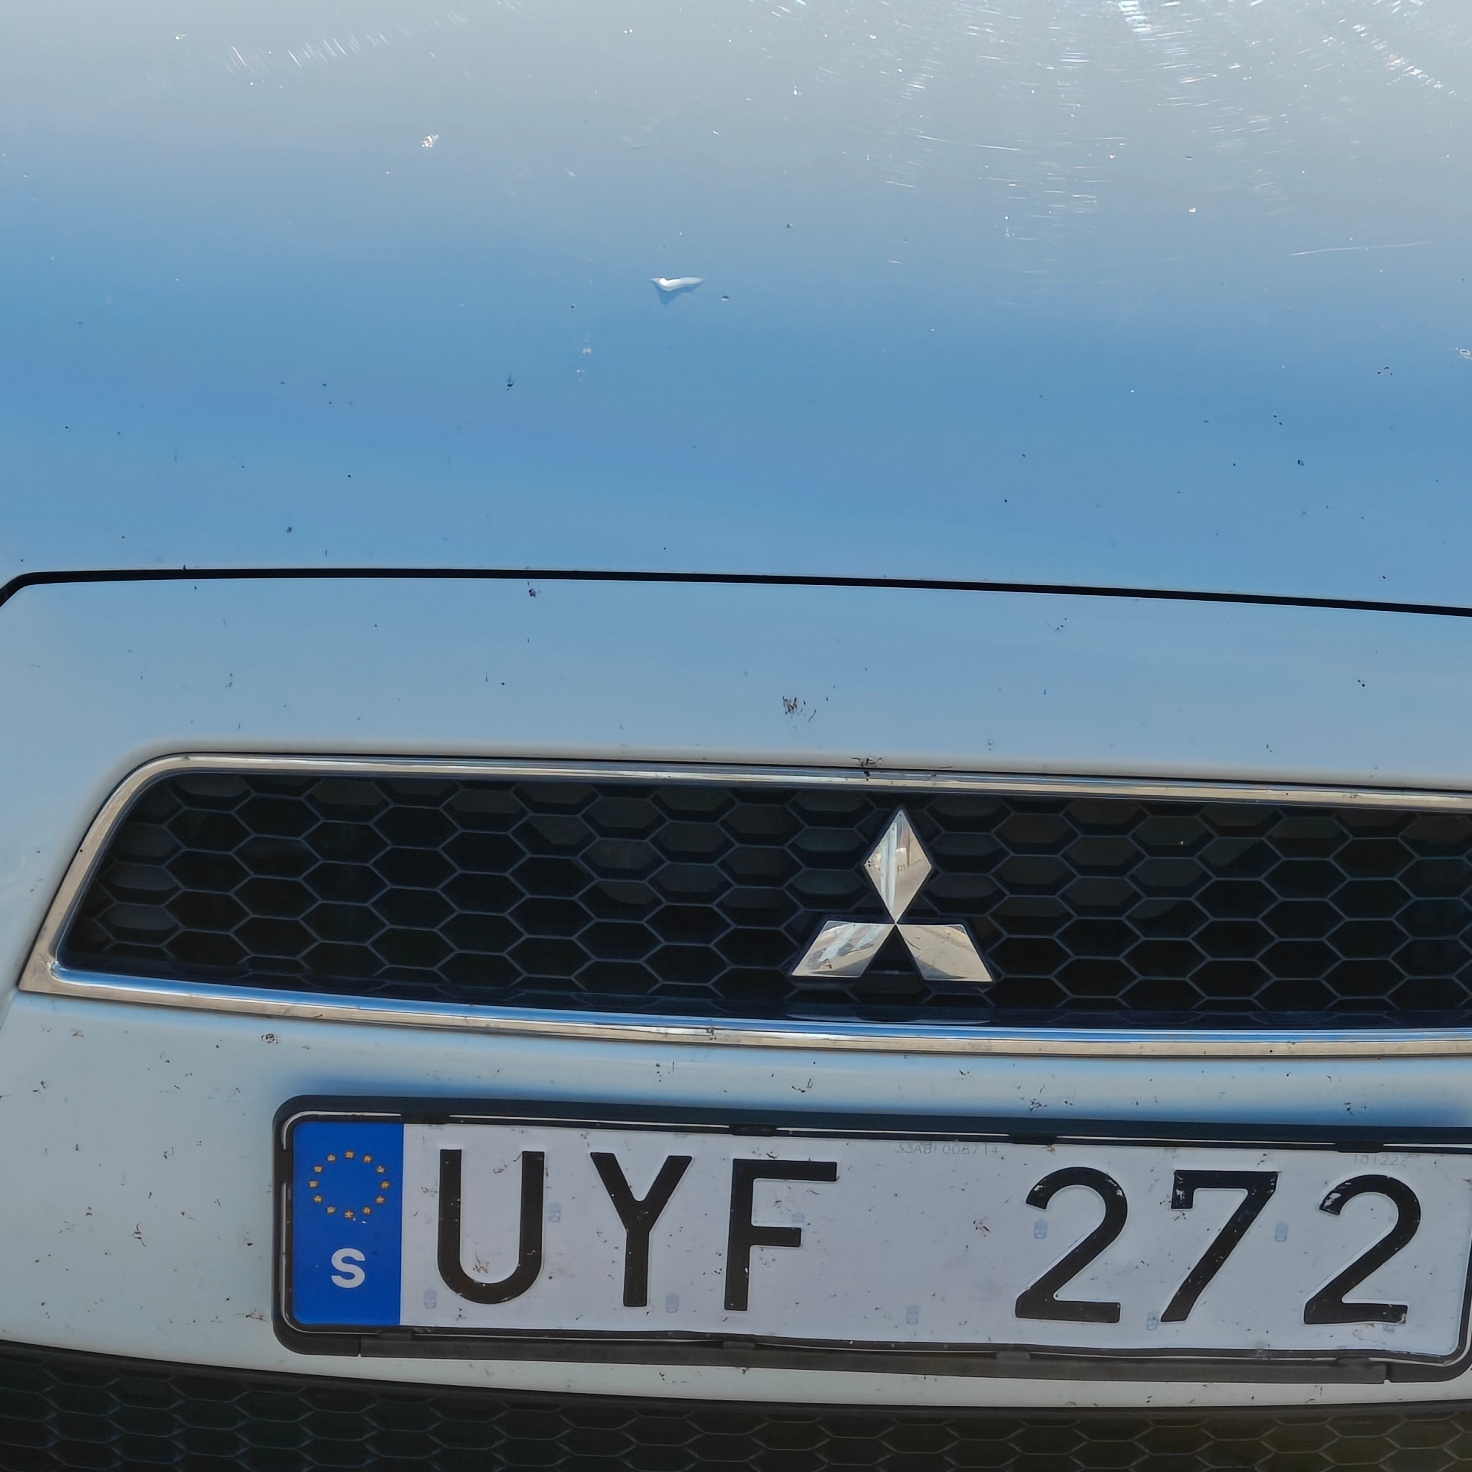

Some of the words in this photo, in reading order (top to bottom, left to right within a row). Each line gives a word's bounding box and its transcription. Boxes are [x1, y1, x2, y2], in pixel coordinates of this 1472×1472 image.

[331, 1247, 366, 1289] S
[437, 1148, 838, 1312] UYF
[1015, 1166, 1421, 1325] 272
